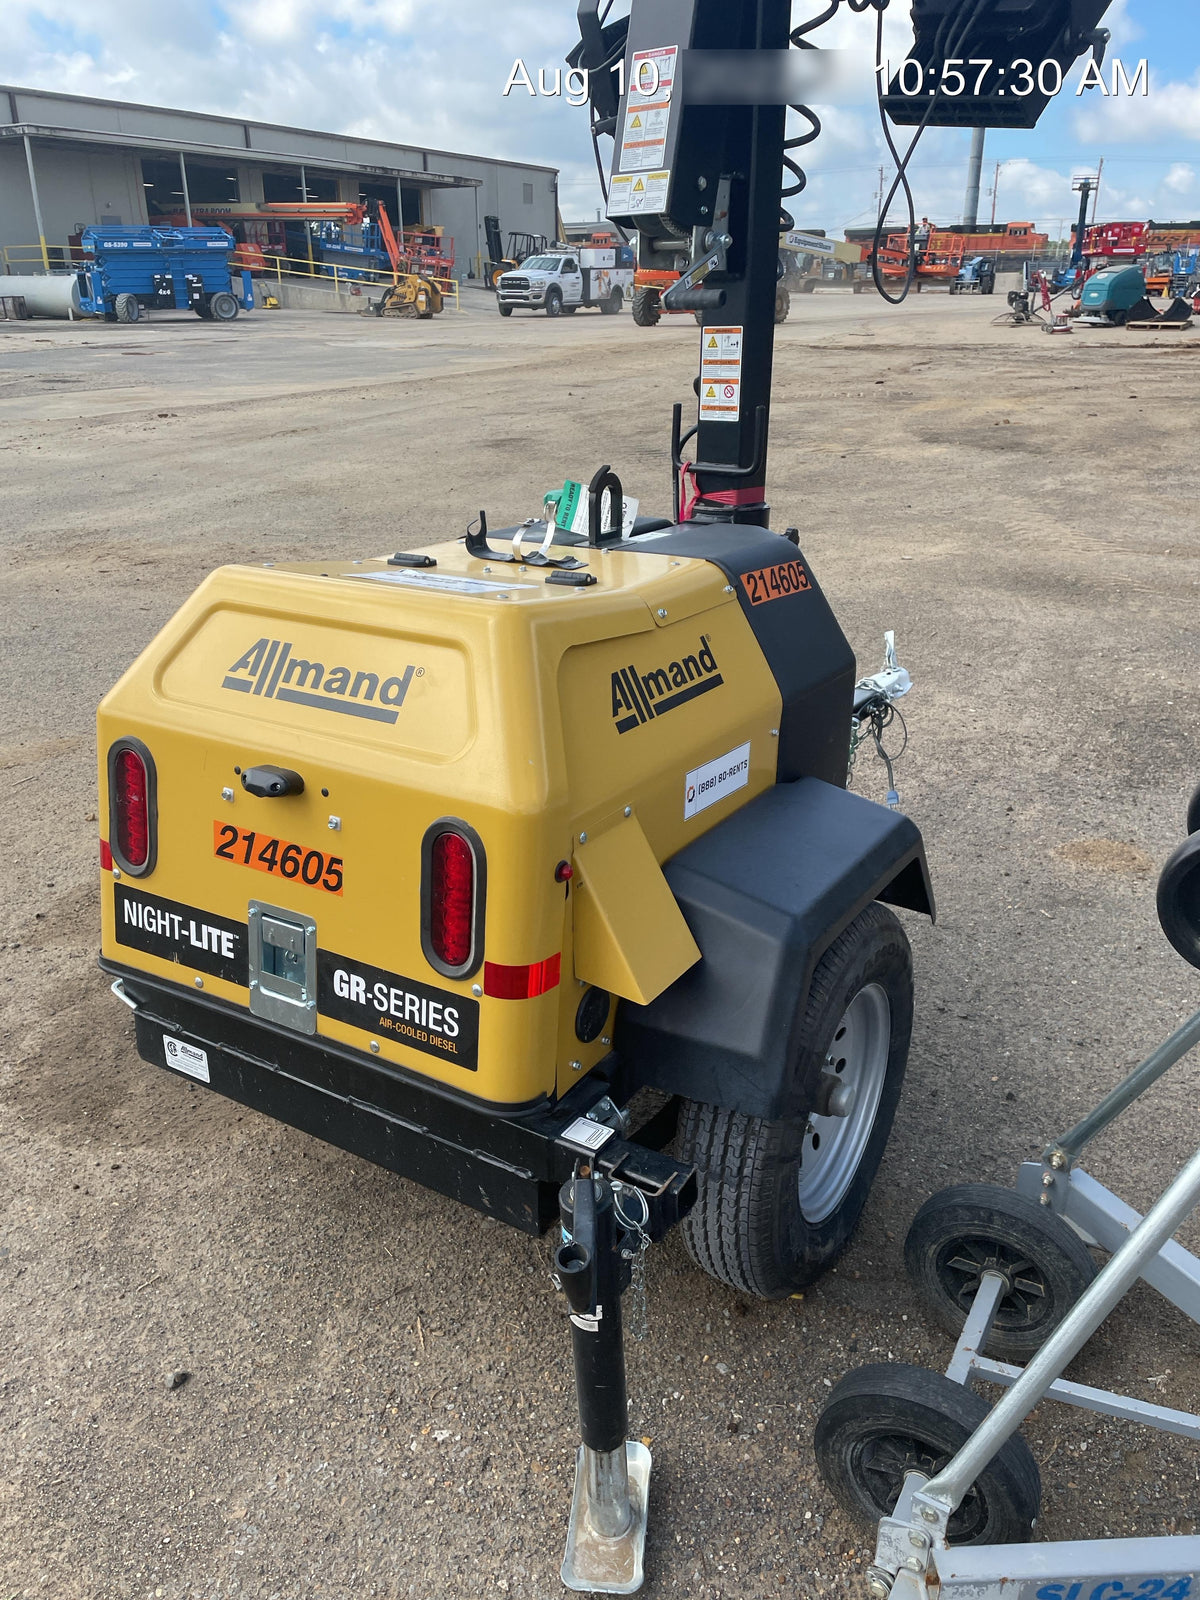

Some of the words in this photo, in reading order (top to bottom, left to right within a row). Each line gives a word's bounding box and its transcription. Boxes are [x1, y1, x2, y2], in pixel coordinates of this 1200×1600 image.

[564, 503, 572, 512] TO
[567, 482, 577, 504] READY
[560, 511, 570, 528] RENT
[746, 560, 809, 604] 214605
[215, 824, 343, 892] 214605
[333, 969, 460, 1038] GR-SERIES
[379, 1016, 429, 1043] AIR-COOLED
[429, 1034, 459, 1055] DIESEL
